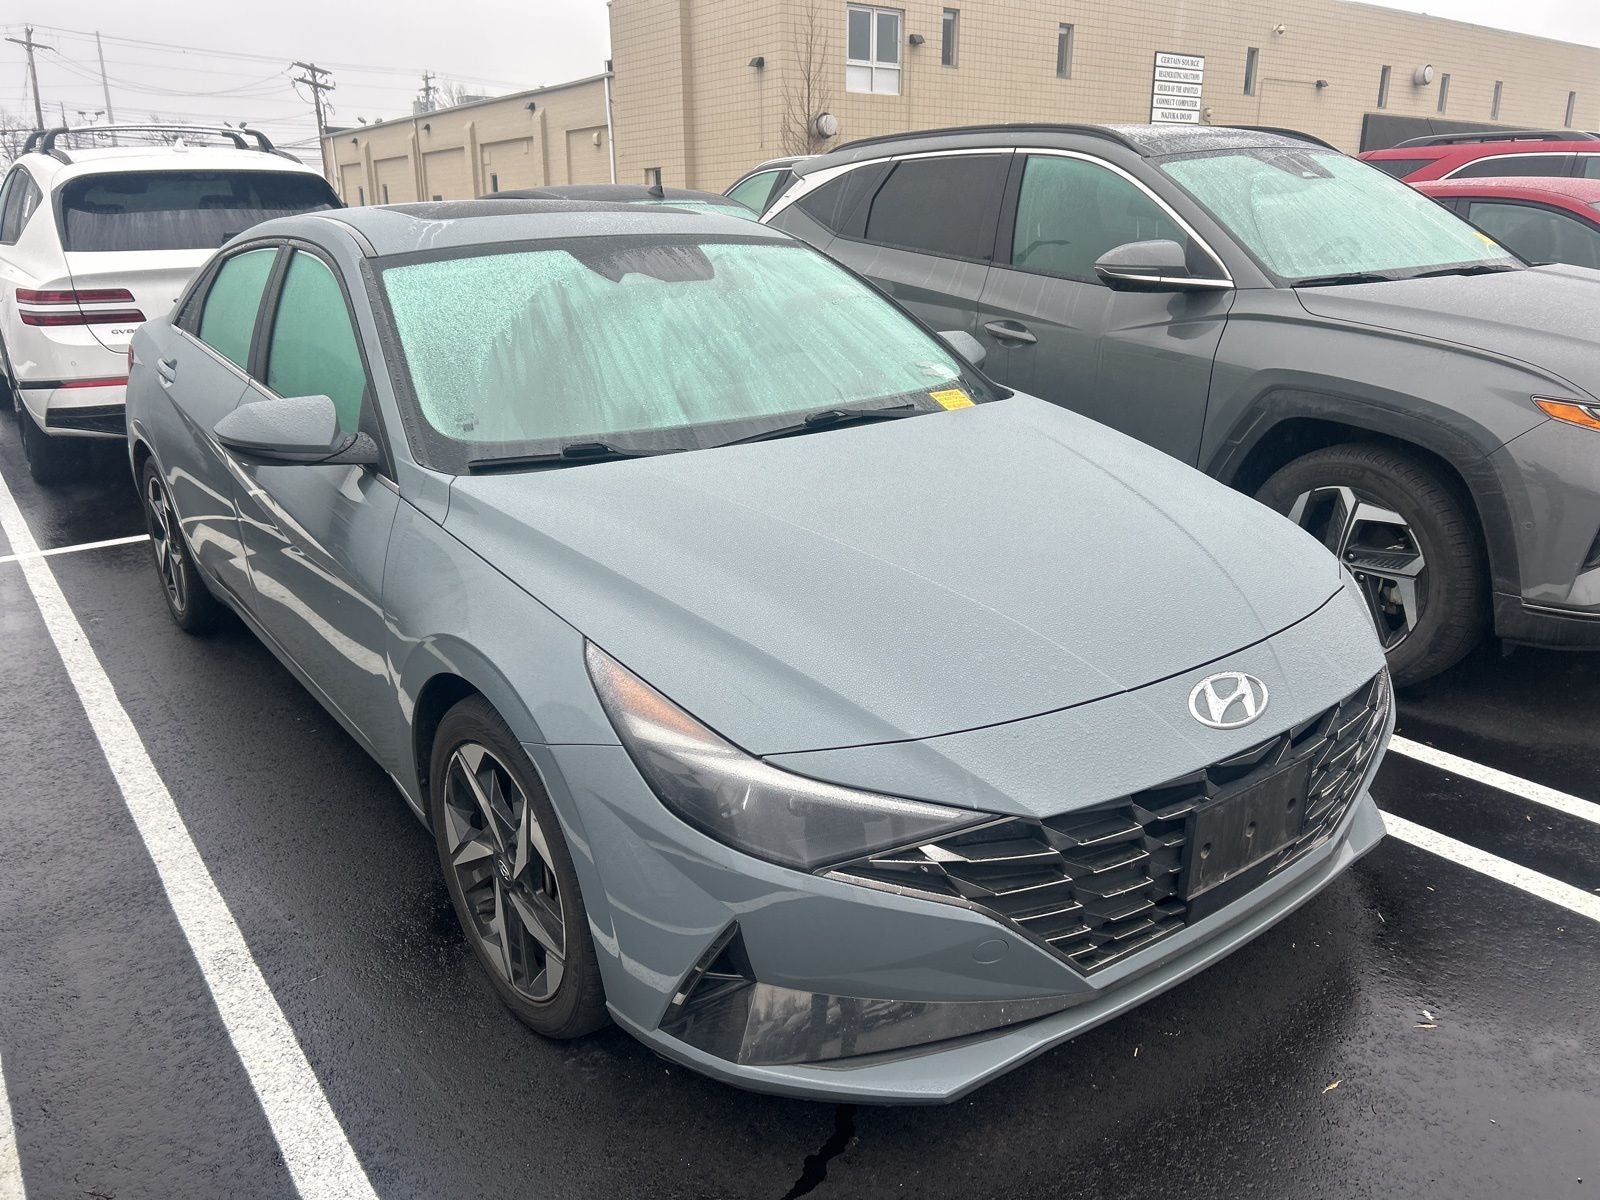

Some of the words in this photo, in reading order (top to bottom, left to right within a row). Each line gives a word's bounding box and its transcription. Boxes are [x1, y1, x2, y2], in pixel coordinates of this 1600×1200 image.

[1160, 56, 1181, 64] CERTAIN
[1182, 58, 1200, 67] SOURCE
[1158, 84, 1170, 92] CHURCH
[1156, 98, 1175, 106] CONNECT
[1175, 98, 1197, 107] COMPUTER
